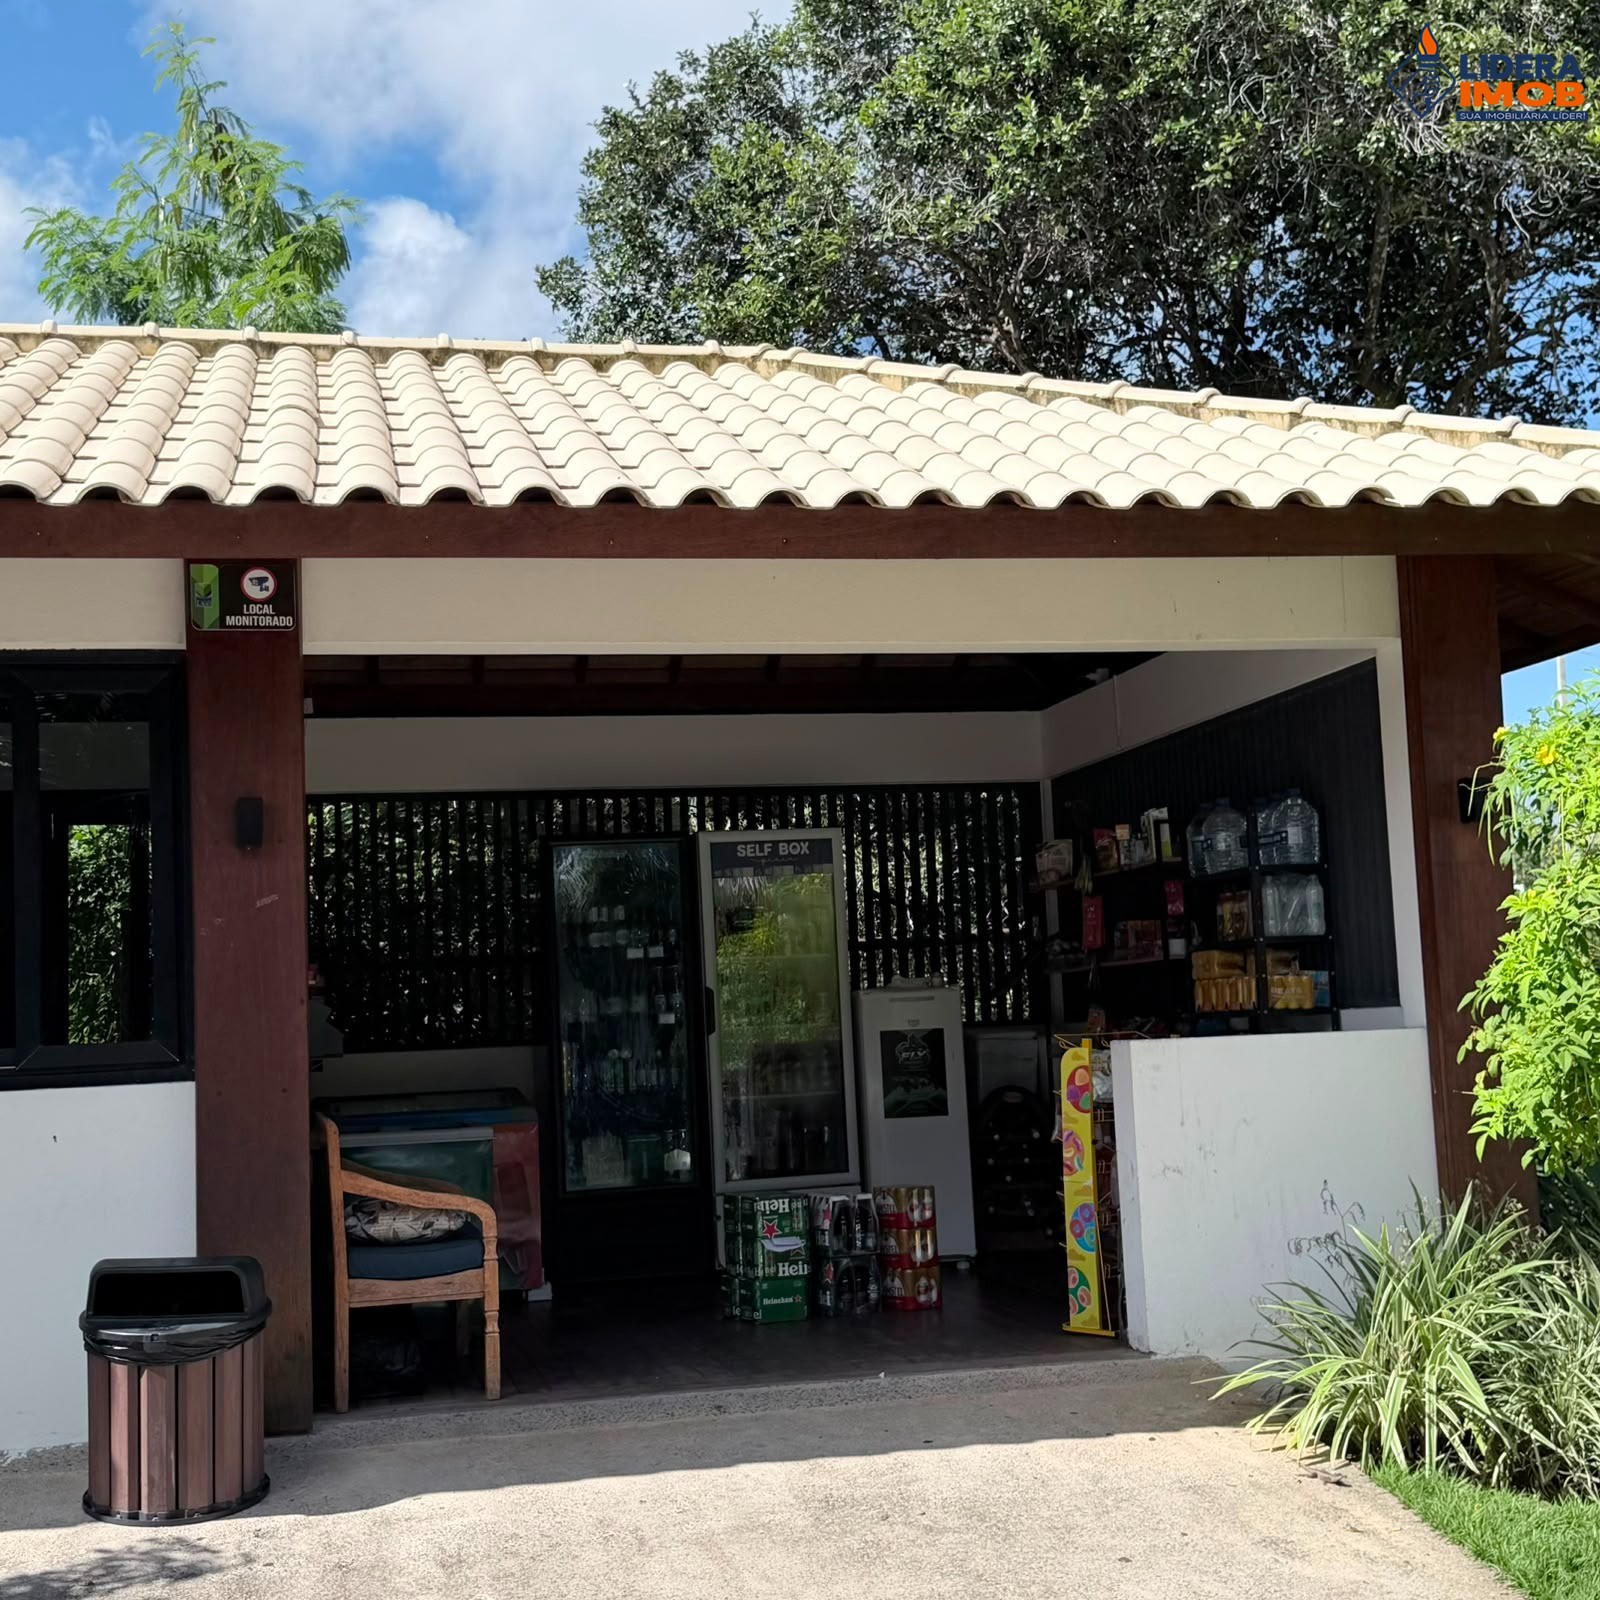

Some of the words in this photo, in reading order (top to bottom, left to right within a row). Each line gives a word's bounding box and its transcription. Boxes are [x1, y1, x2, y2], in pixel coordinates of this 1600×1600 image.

[243, 604, 275, 614] LOCAL
[225, 615, 293, 626] MONITORADO
[736, 843, 773, 857] SELF
[778, 841, 810, 856] BOX
